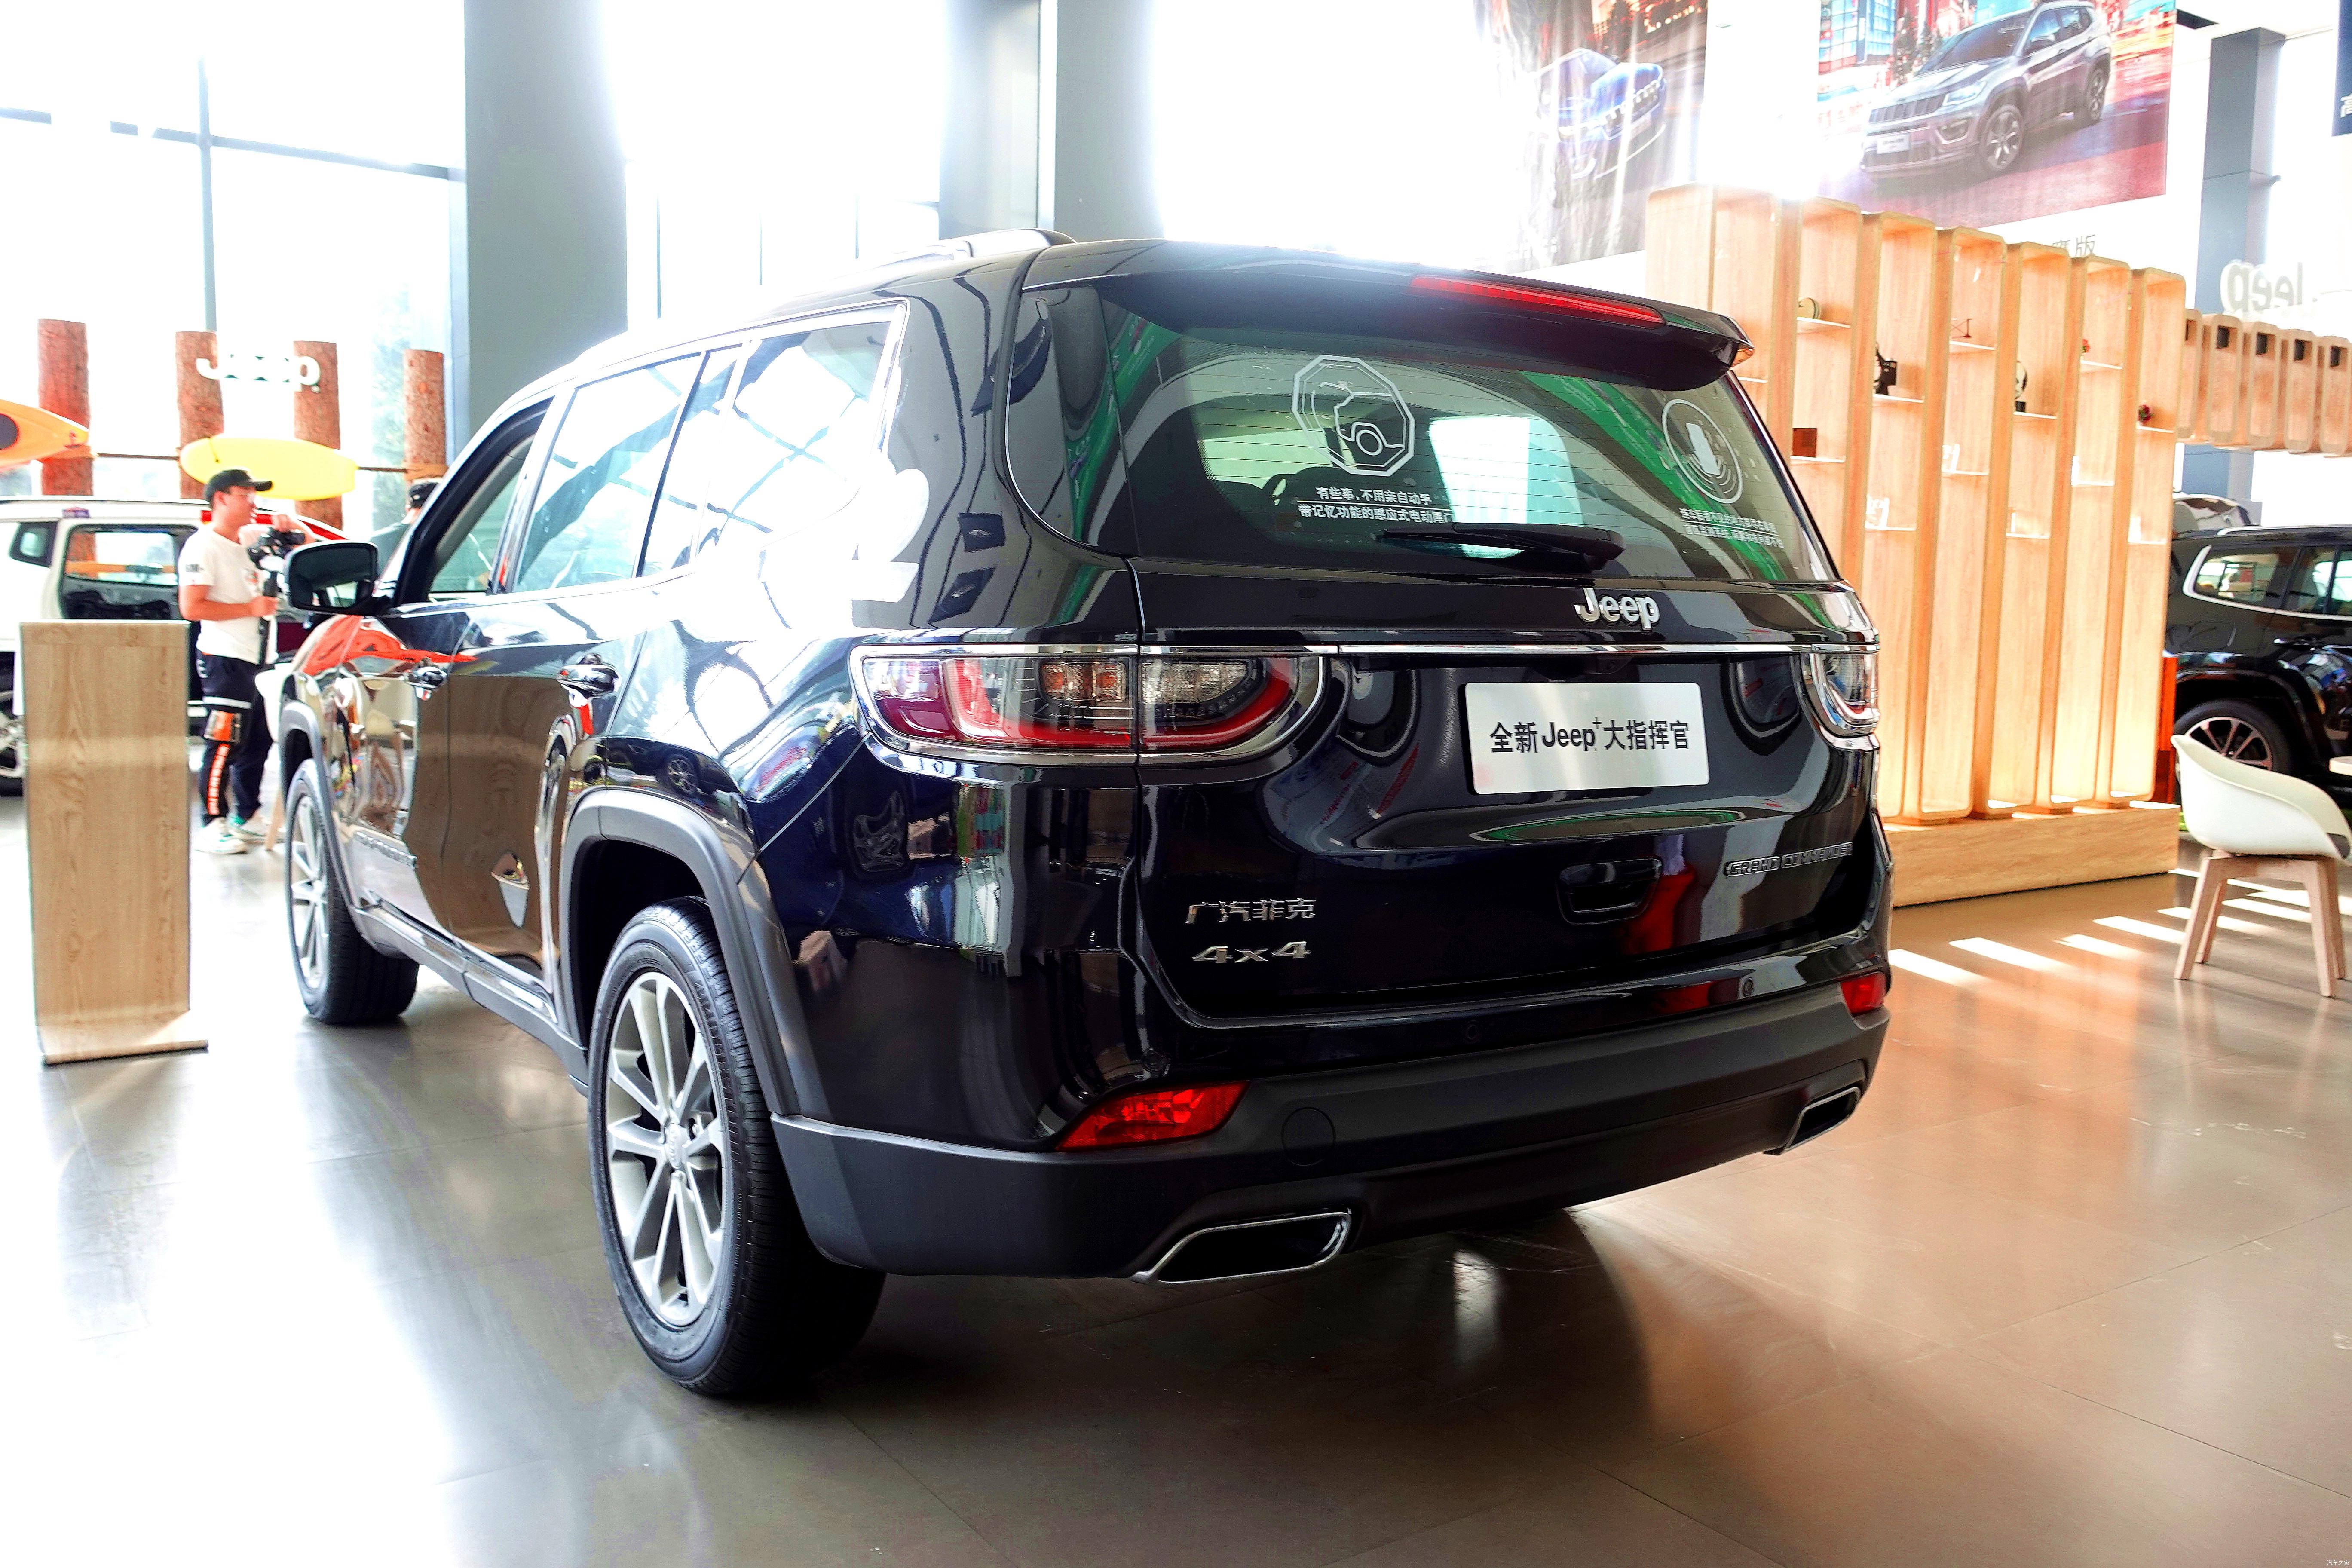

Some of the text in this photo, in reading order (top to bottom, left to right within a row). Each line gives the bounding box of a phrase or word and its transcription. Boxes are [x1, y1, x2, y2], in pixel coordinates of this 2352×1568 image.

[1574, 587, 1660, 631] Jeep
[1726, 856, 1781, 877] GRAND
[1183, 897, 1317, 924] 广汽菲克
